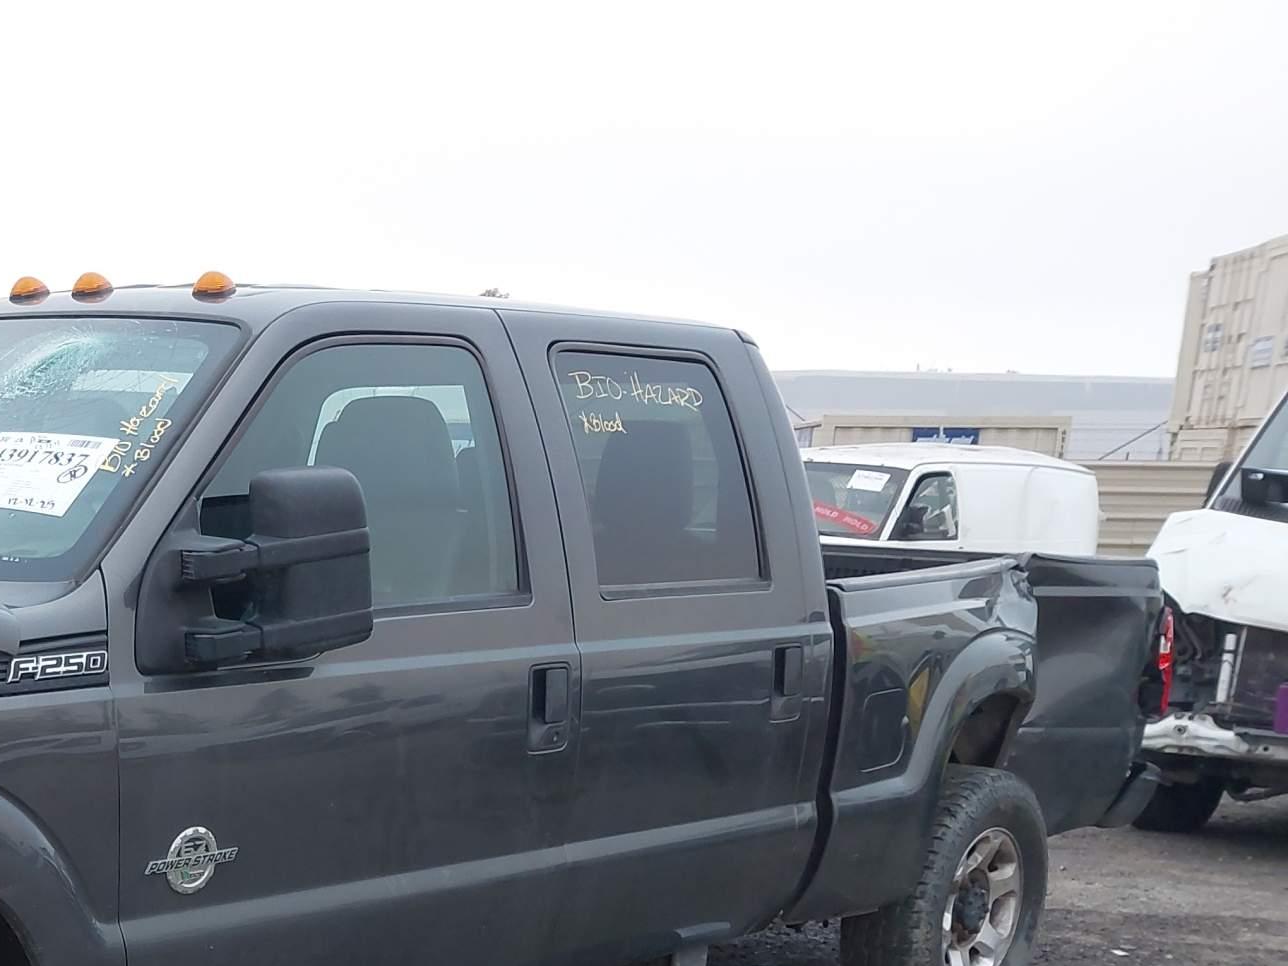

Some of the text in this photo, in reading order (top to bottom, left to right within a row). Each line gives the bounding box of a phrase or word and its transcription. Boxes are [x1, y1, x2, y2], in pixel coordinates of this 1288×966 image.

[7, 650, 108, 684] F-250
[148, 848, 238, 873] POWER STROKE
